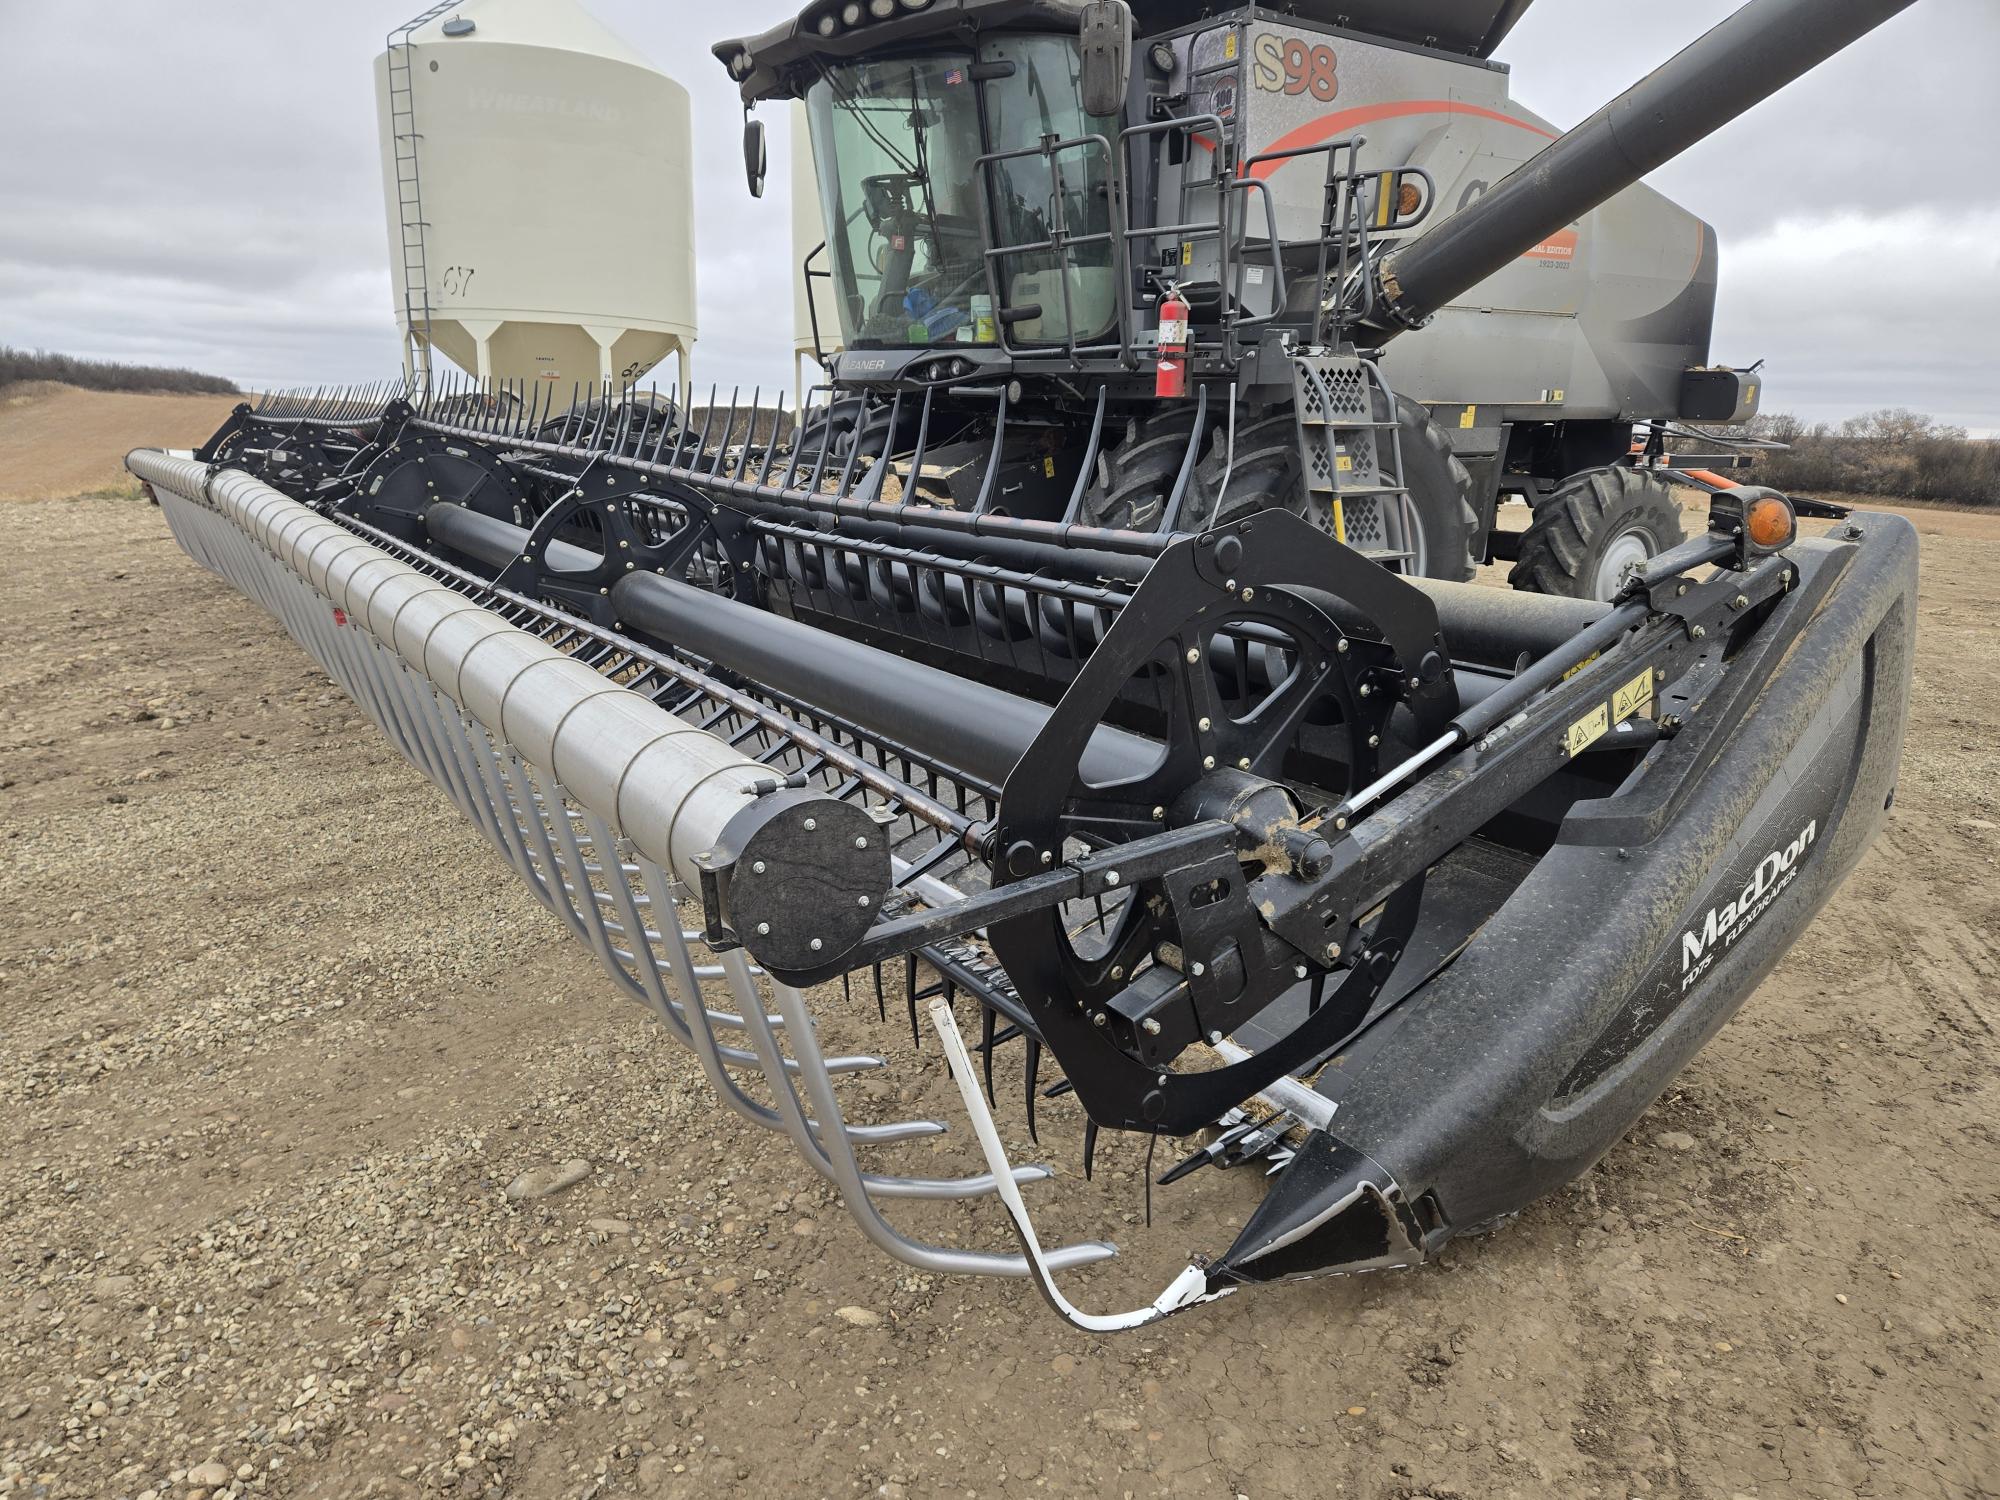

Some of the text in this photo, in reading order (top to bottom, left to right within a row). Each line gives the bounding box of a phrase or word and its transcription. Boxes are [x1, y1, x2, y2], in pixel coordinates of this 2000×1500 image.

[1253, 33, 1338, 102] S98
[1682, 819, 1816, 974] MacDon
[1725, 866, 1797, 947] FLEXDRAPER
